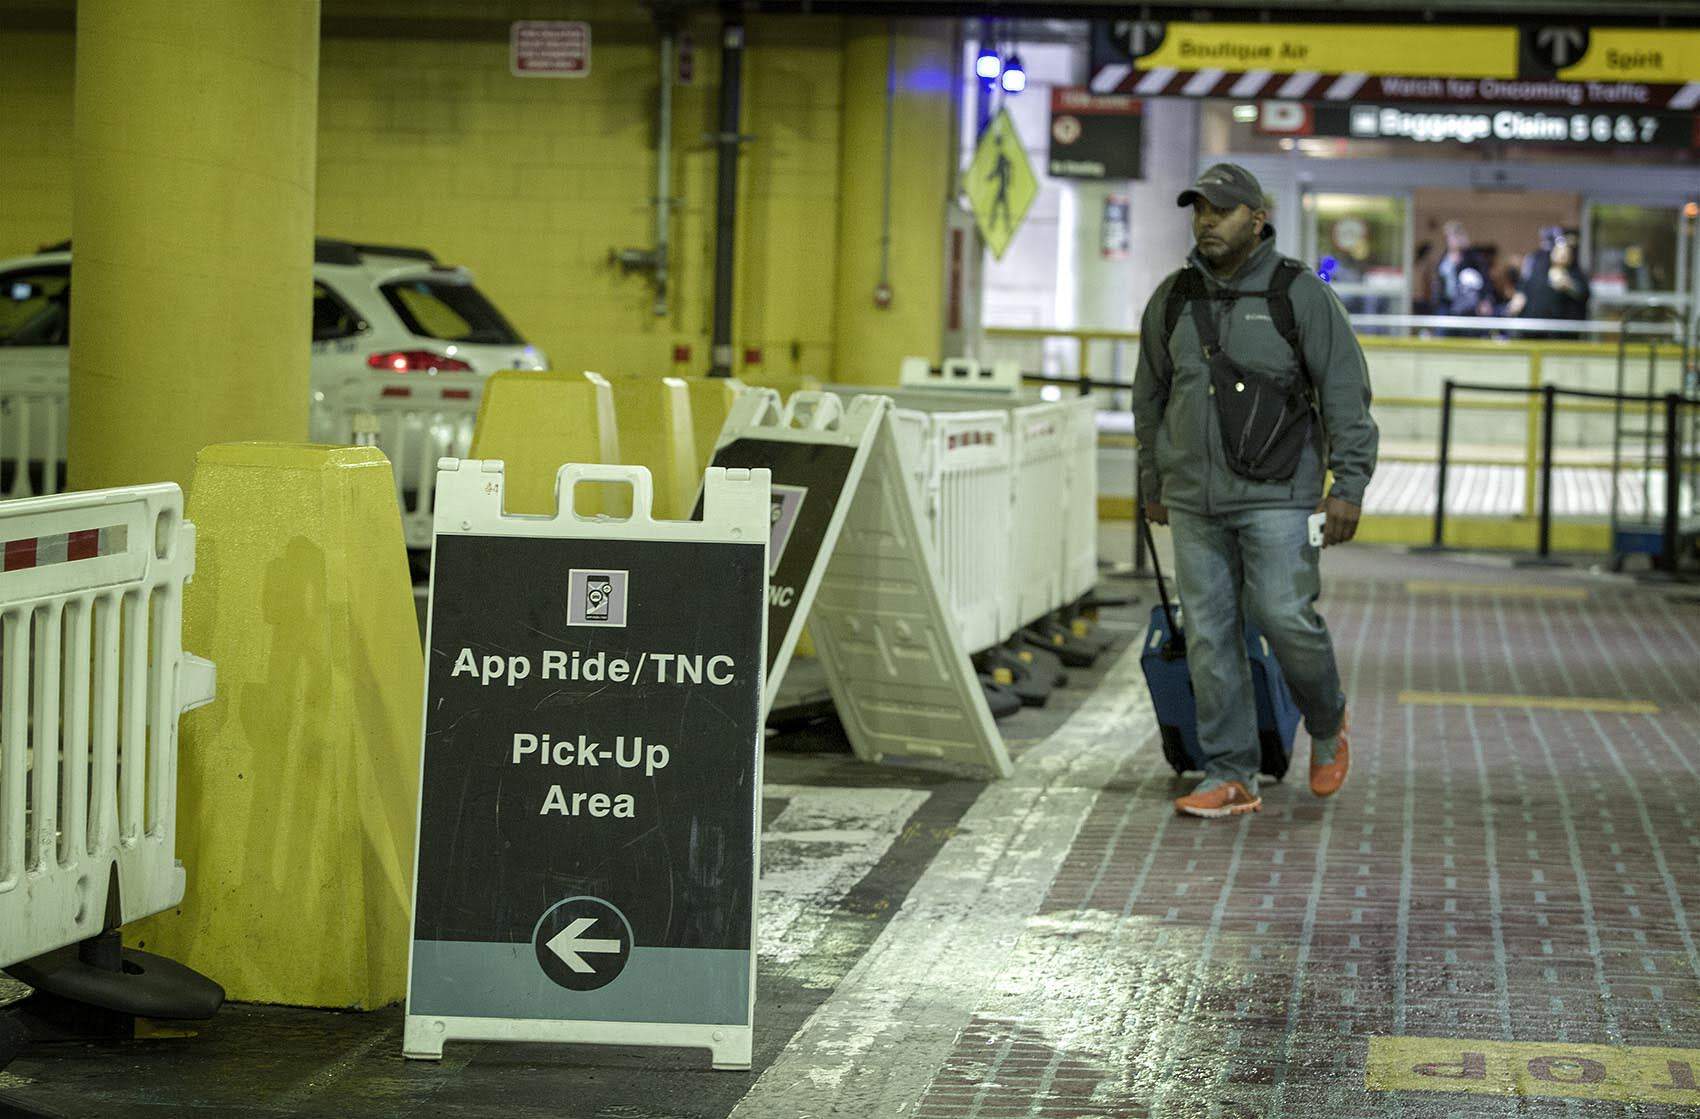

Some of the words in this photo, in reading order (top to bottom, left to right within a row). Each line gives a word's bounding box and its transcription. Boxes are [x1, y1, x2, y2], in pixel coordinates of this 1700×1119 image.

[1180, 39, 1273, 61] Boutique
[1279, 40, 1308, 60] Air
[1606, 48, 1662, 69] Spirit
[1381, 77, 1443, 96] Watch
[1448, 78, 1476, 97] for
[1479, 79, 1583, 104] Oncoming
[1587, 81, 1648, 102] Traffic
[1379, 108, 1491, 142] Baggage
[1493, 110, 1568, 140] Claim
[1638, 115, 1658, 143] 7
[769, 585, 794, 607] NC
[451, 648, 531, 686] App
[541, 650, 736, 686] Ride/TNC
[512, 733, 670, 777] Pick-Up
[540, 784, 635, 818] Area
